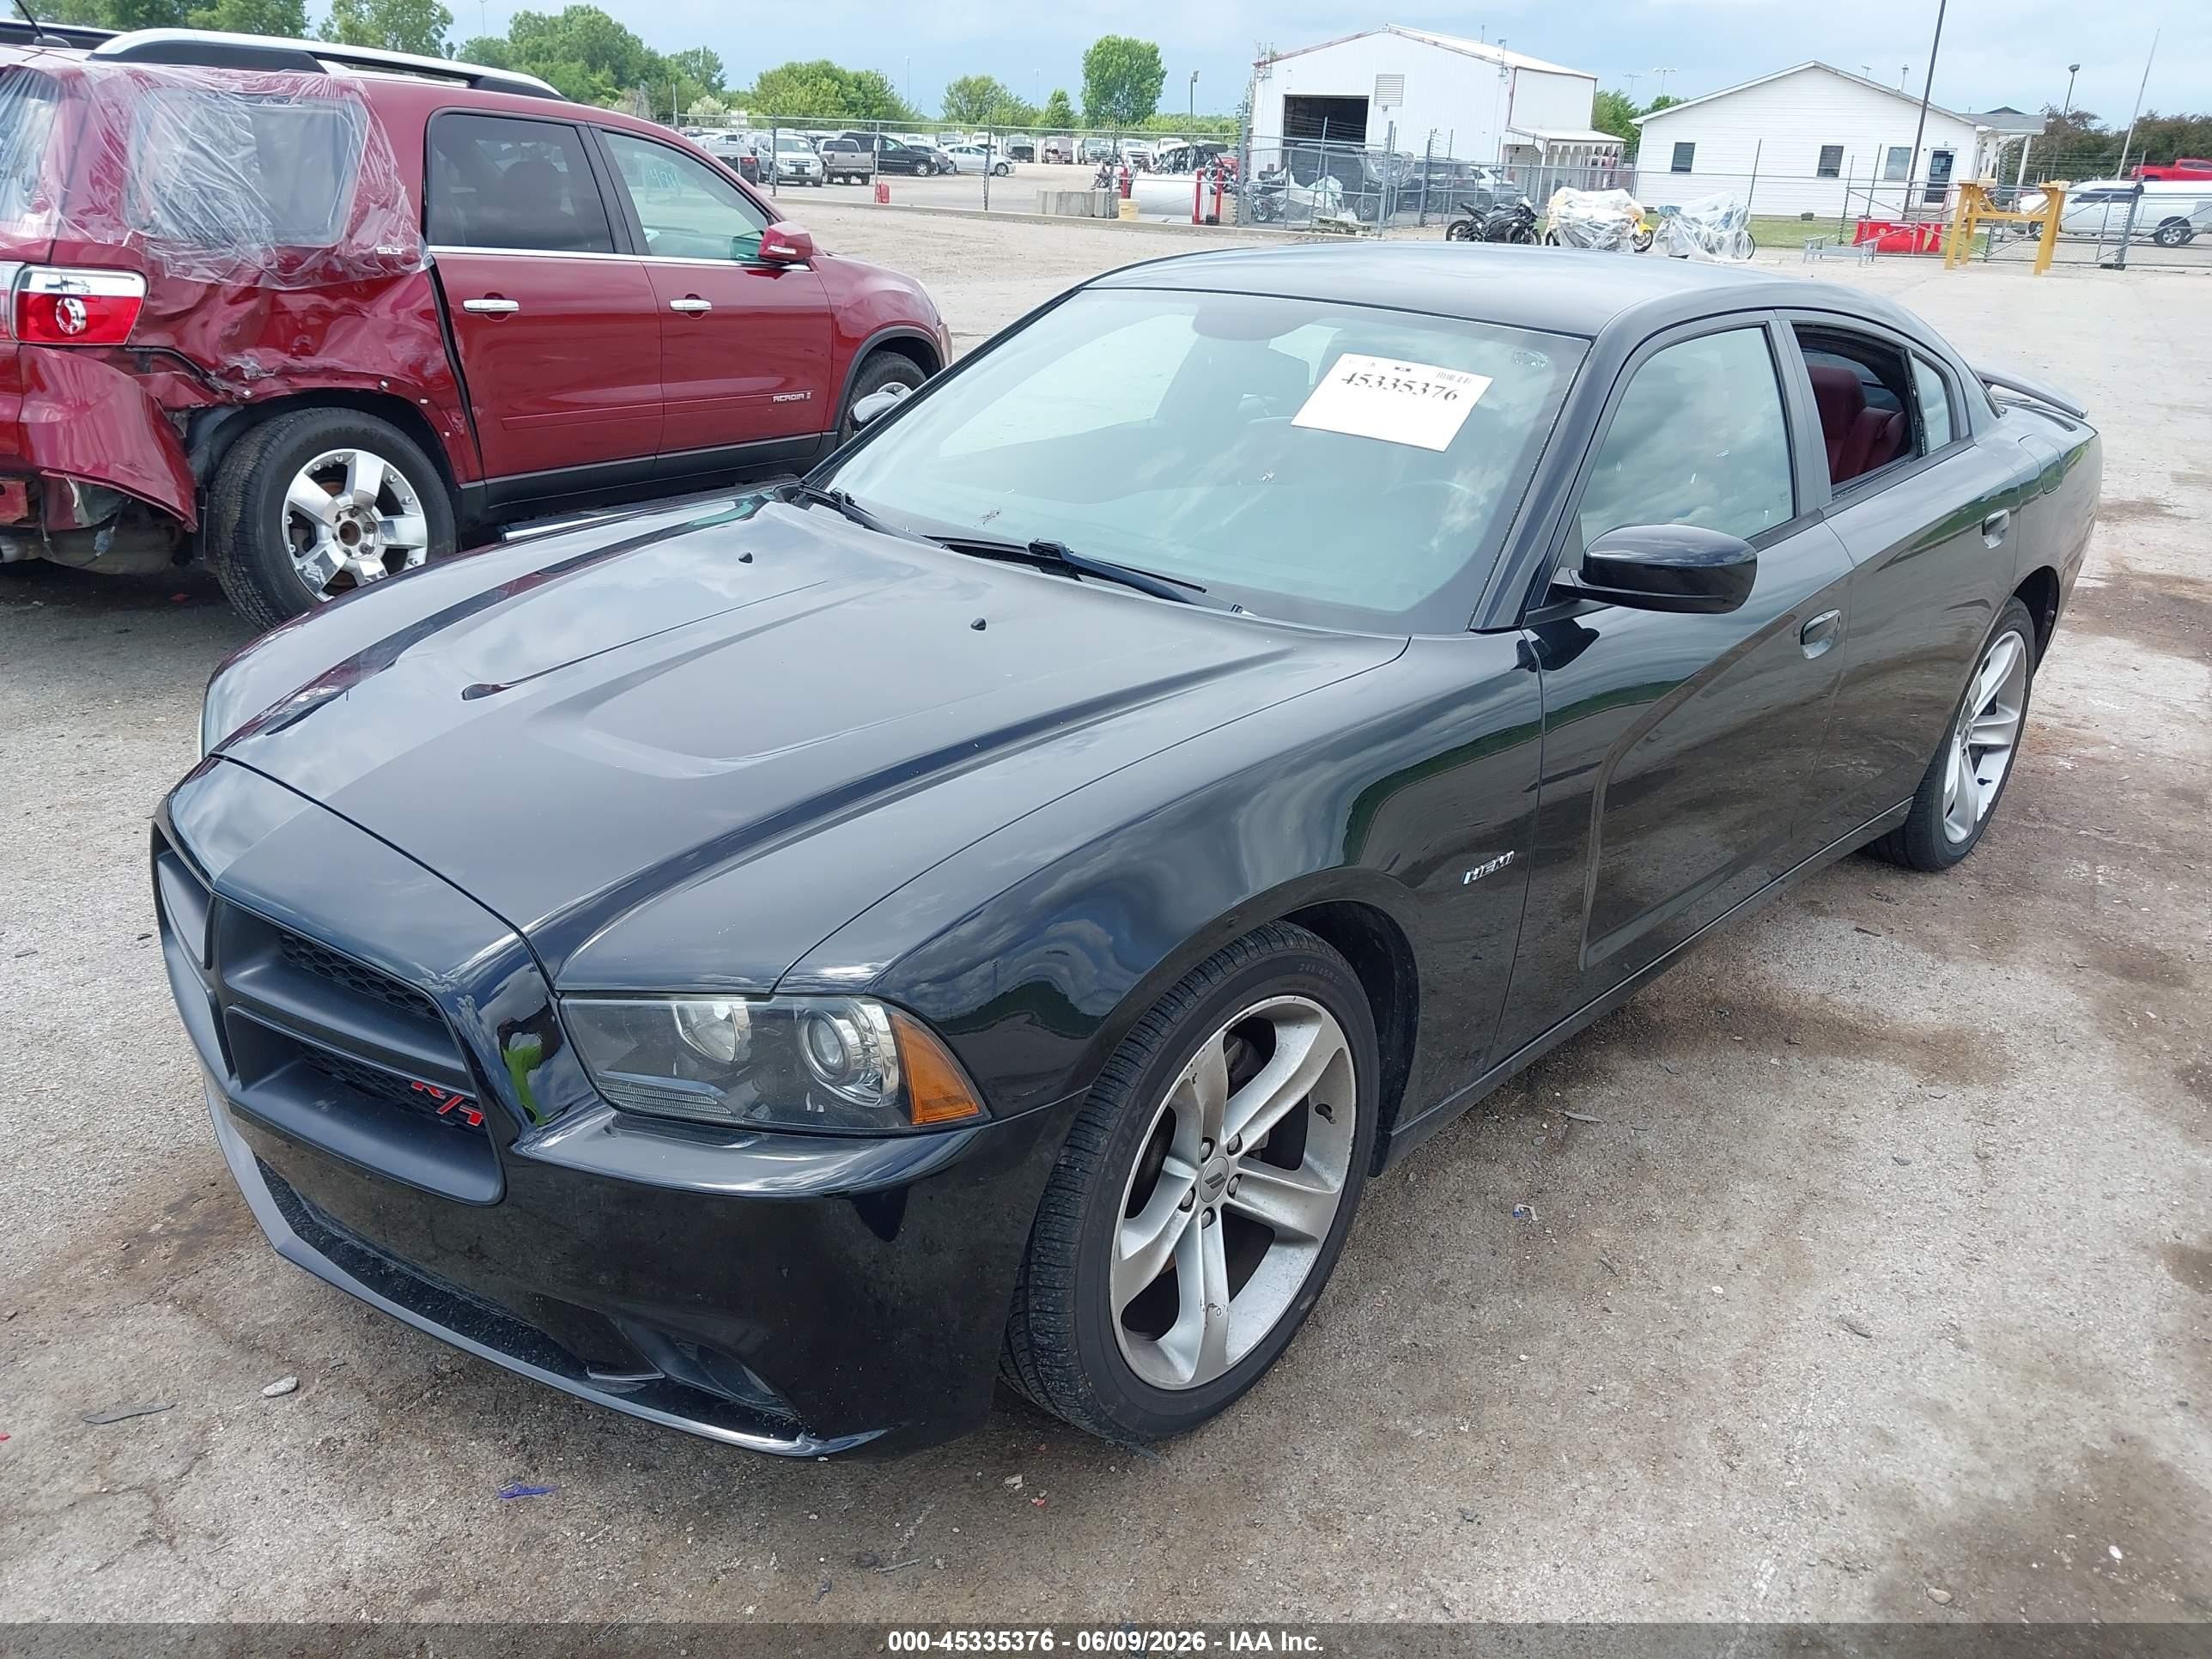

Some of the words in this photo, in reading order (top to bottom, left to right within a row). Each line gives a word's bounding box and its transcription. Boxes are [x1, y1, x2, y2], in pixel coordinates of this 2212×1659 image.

[376, 246, 405, 255] SLT
[773, 393, 805, 403] ACADIA
[1340, 371, 1459, 401] 45335376
[1463, 850, 1515, 884] HEMI
[411, 1080, 484, 1127] R/T
